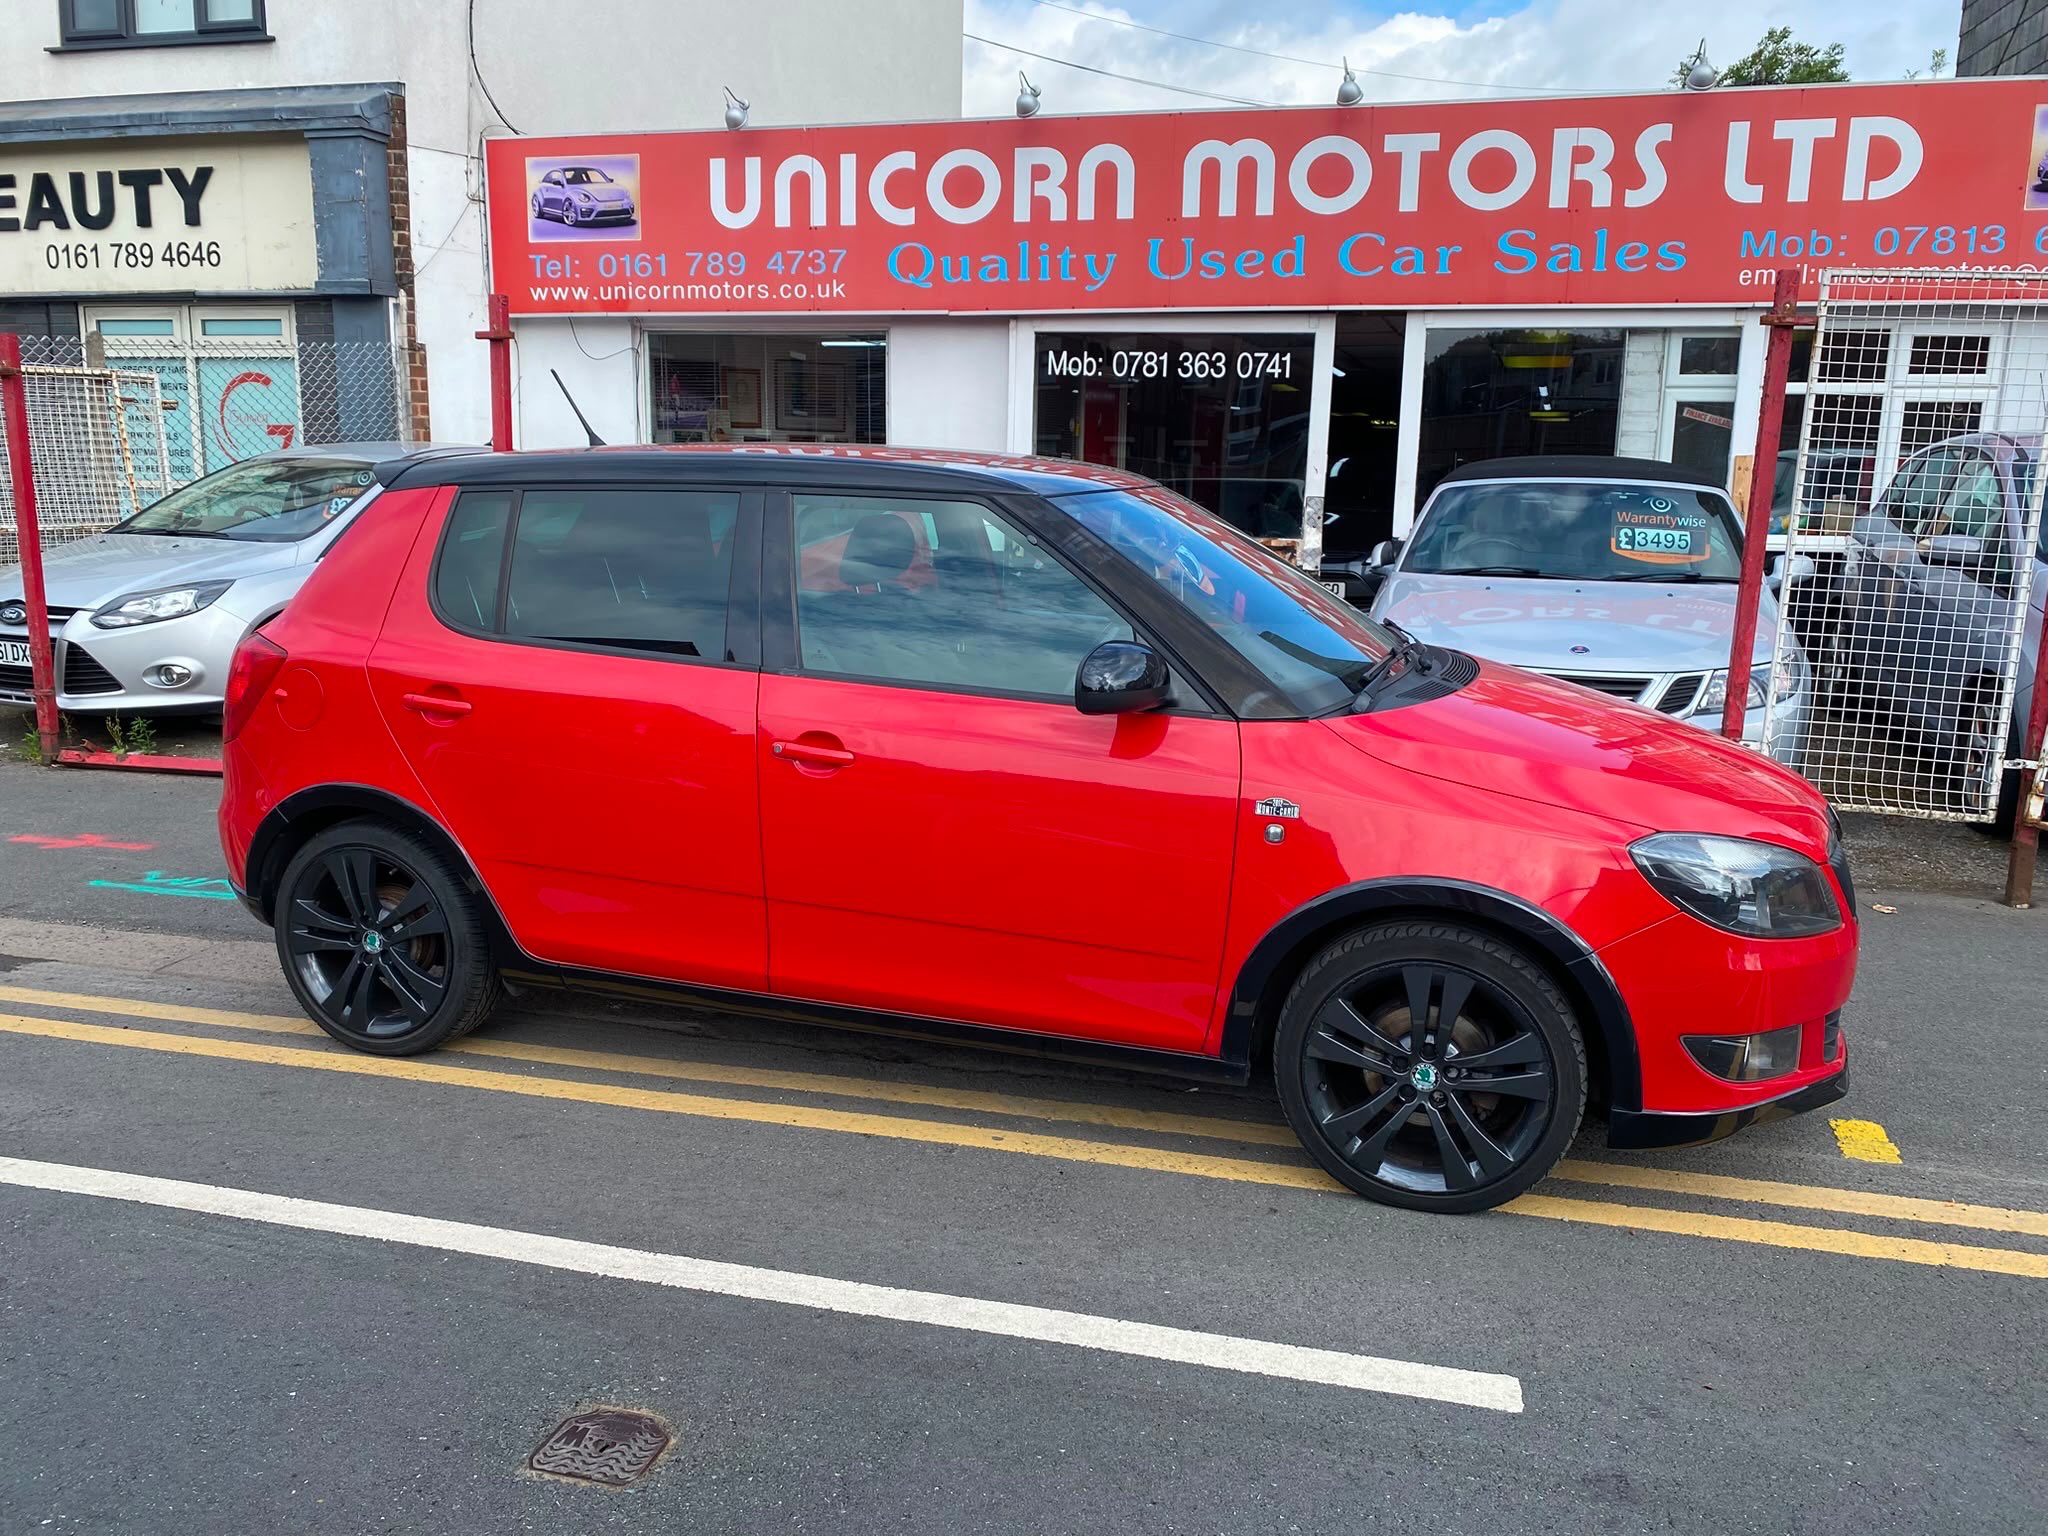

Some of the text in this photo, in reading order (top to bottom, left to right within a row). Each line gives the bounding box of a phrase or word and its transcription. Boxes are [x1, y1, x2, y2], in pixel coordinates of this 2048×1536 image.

[708, 115, 1924, 230] UNICORN MOTORS LTD
[46, 241, 221, 270] 0161 789 4646
[1740, 229, 1848, 258] Mob:
[1873, 224, 2006, 256] 07813
[528, 248, 847, 279] Tel: 0161 789 4737
[886, 227, 1687, 292] Quality Used Car Sales
[529, 279, 846, 302] www.unicornmotors.co.uk
[1047, 350, 1292, 379] Mob: 0781 363 0741
[1616, 511, 1706, 528] Warrantywise
[1619, 528, 1690, 550] £3495
[11, 643, 32, 663] DX
